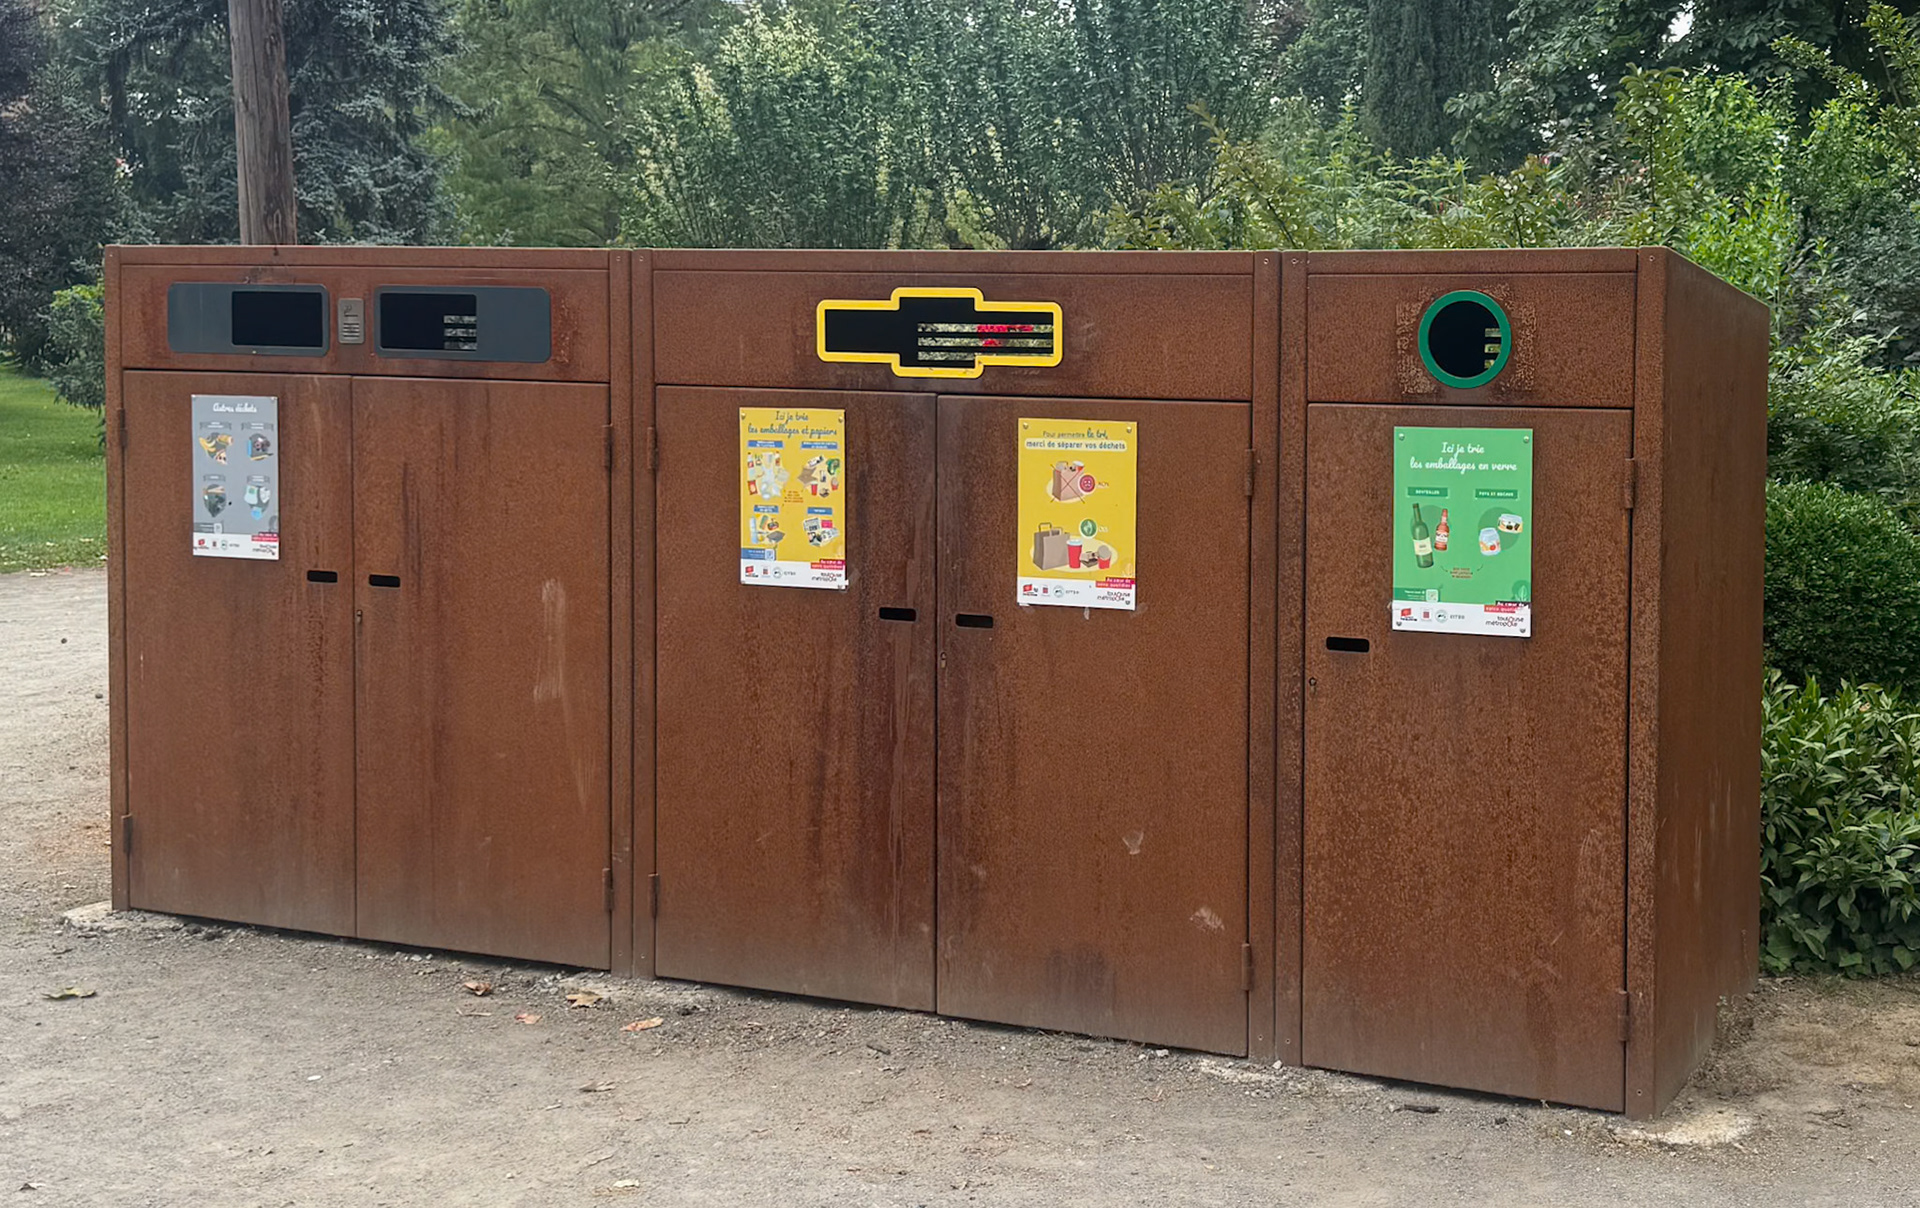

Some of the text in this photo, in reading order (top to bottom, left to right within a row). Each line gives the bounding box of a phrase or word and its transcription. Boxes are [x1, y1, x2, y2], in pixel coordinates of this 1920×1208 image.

[776, 411, 808, 424] Ici je trie
[748, 423, 837, 439] les emballages et papiers
[1087, 427, 1094, 438] le
[1057, 441, 1083, 450] séparer
[1441, 442, 1485, 460] Ici je trie
[1410, 456, 1422, 469] les
[1425, 457, 1476, 475] emballages
[1491, 463, 1517, 471] verre
